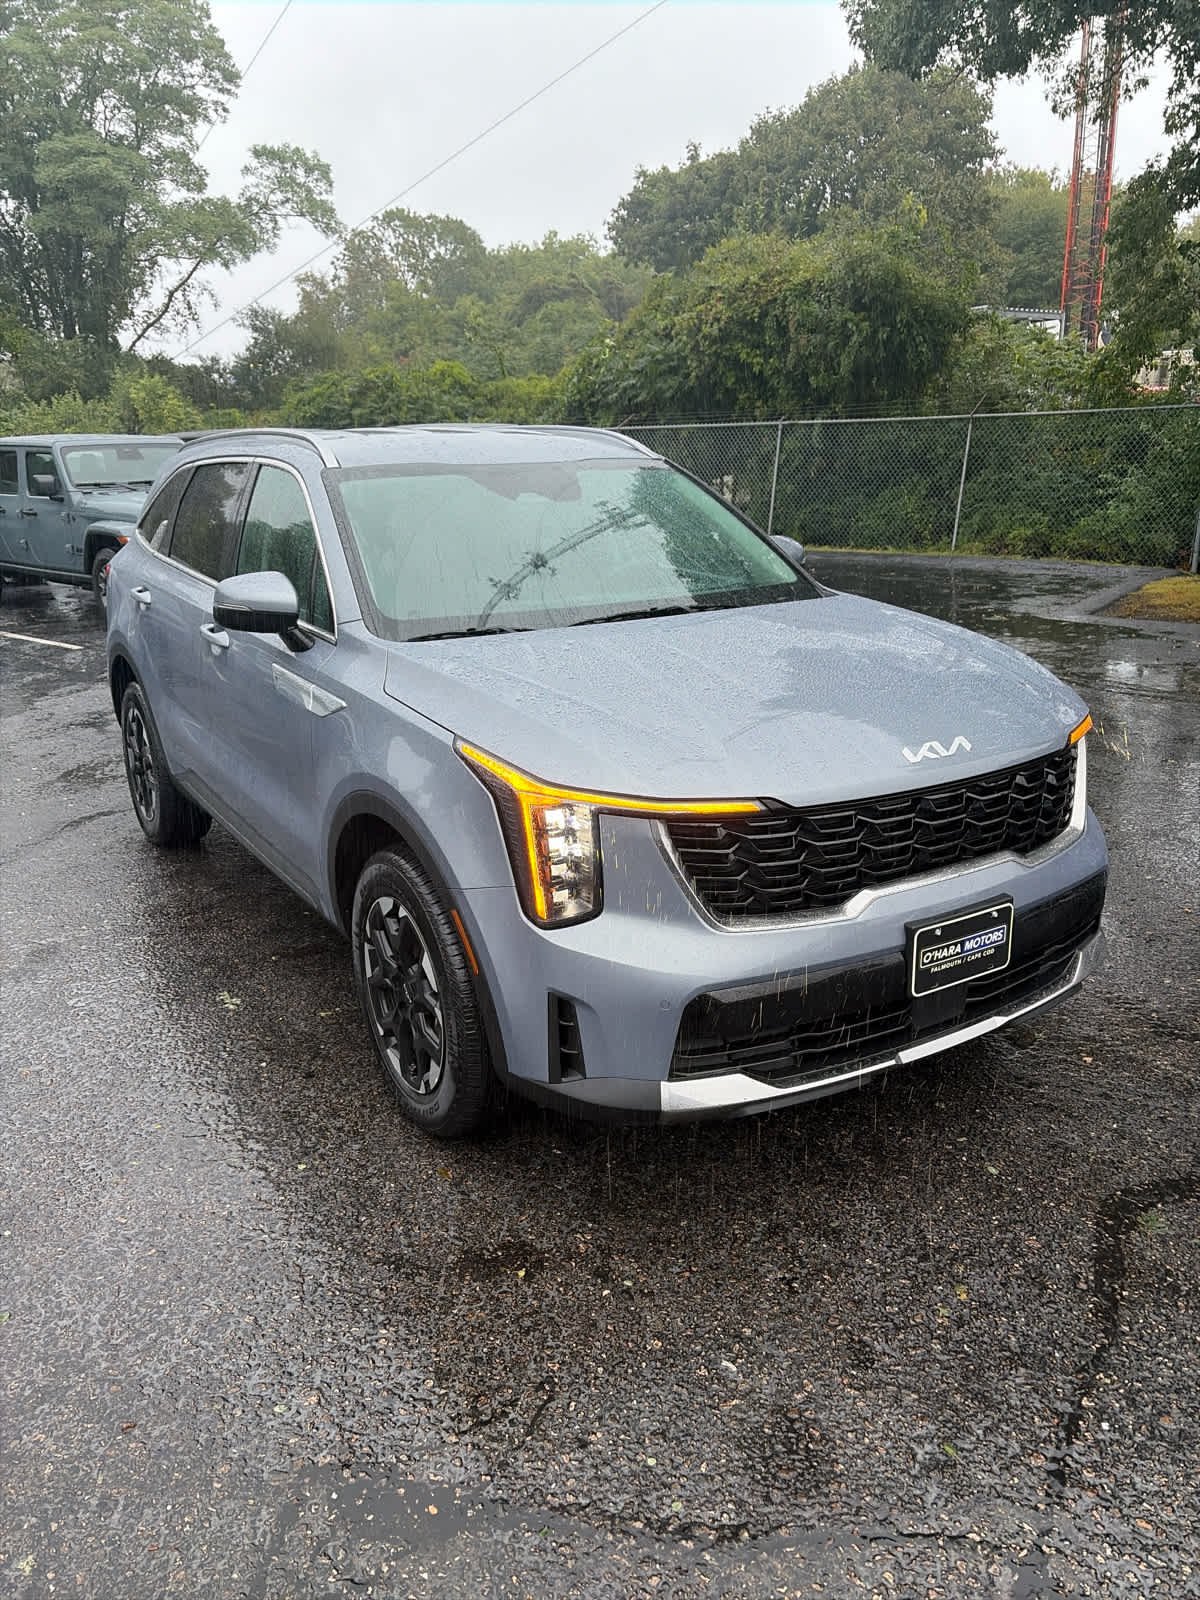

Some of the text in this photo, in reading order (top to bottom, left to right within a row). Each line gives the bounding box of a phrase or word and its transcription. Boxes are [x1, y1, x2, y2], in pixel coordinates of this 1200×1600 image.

[902, 736, 972, 764] KIA
[923, 930, 1003, 963] O'HARA MOTORS
[967, 952, 981, 962] CAPE
